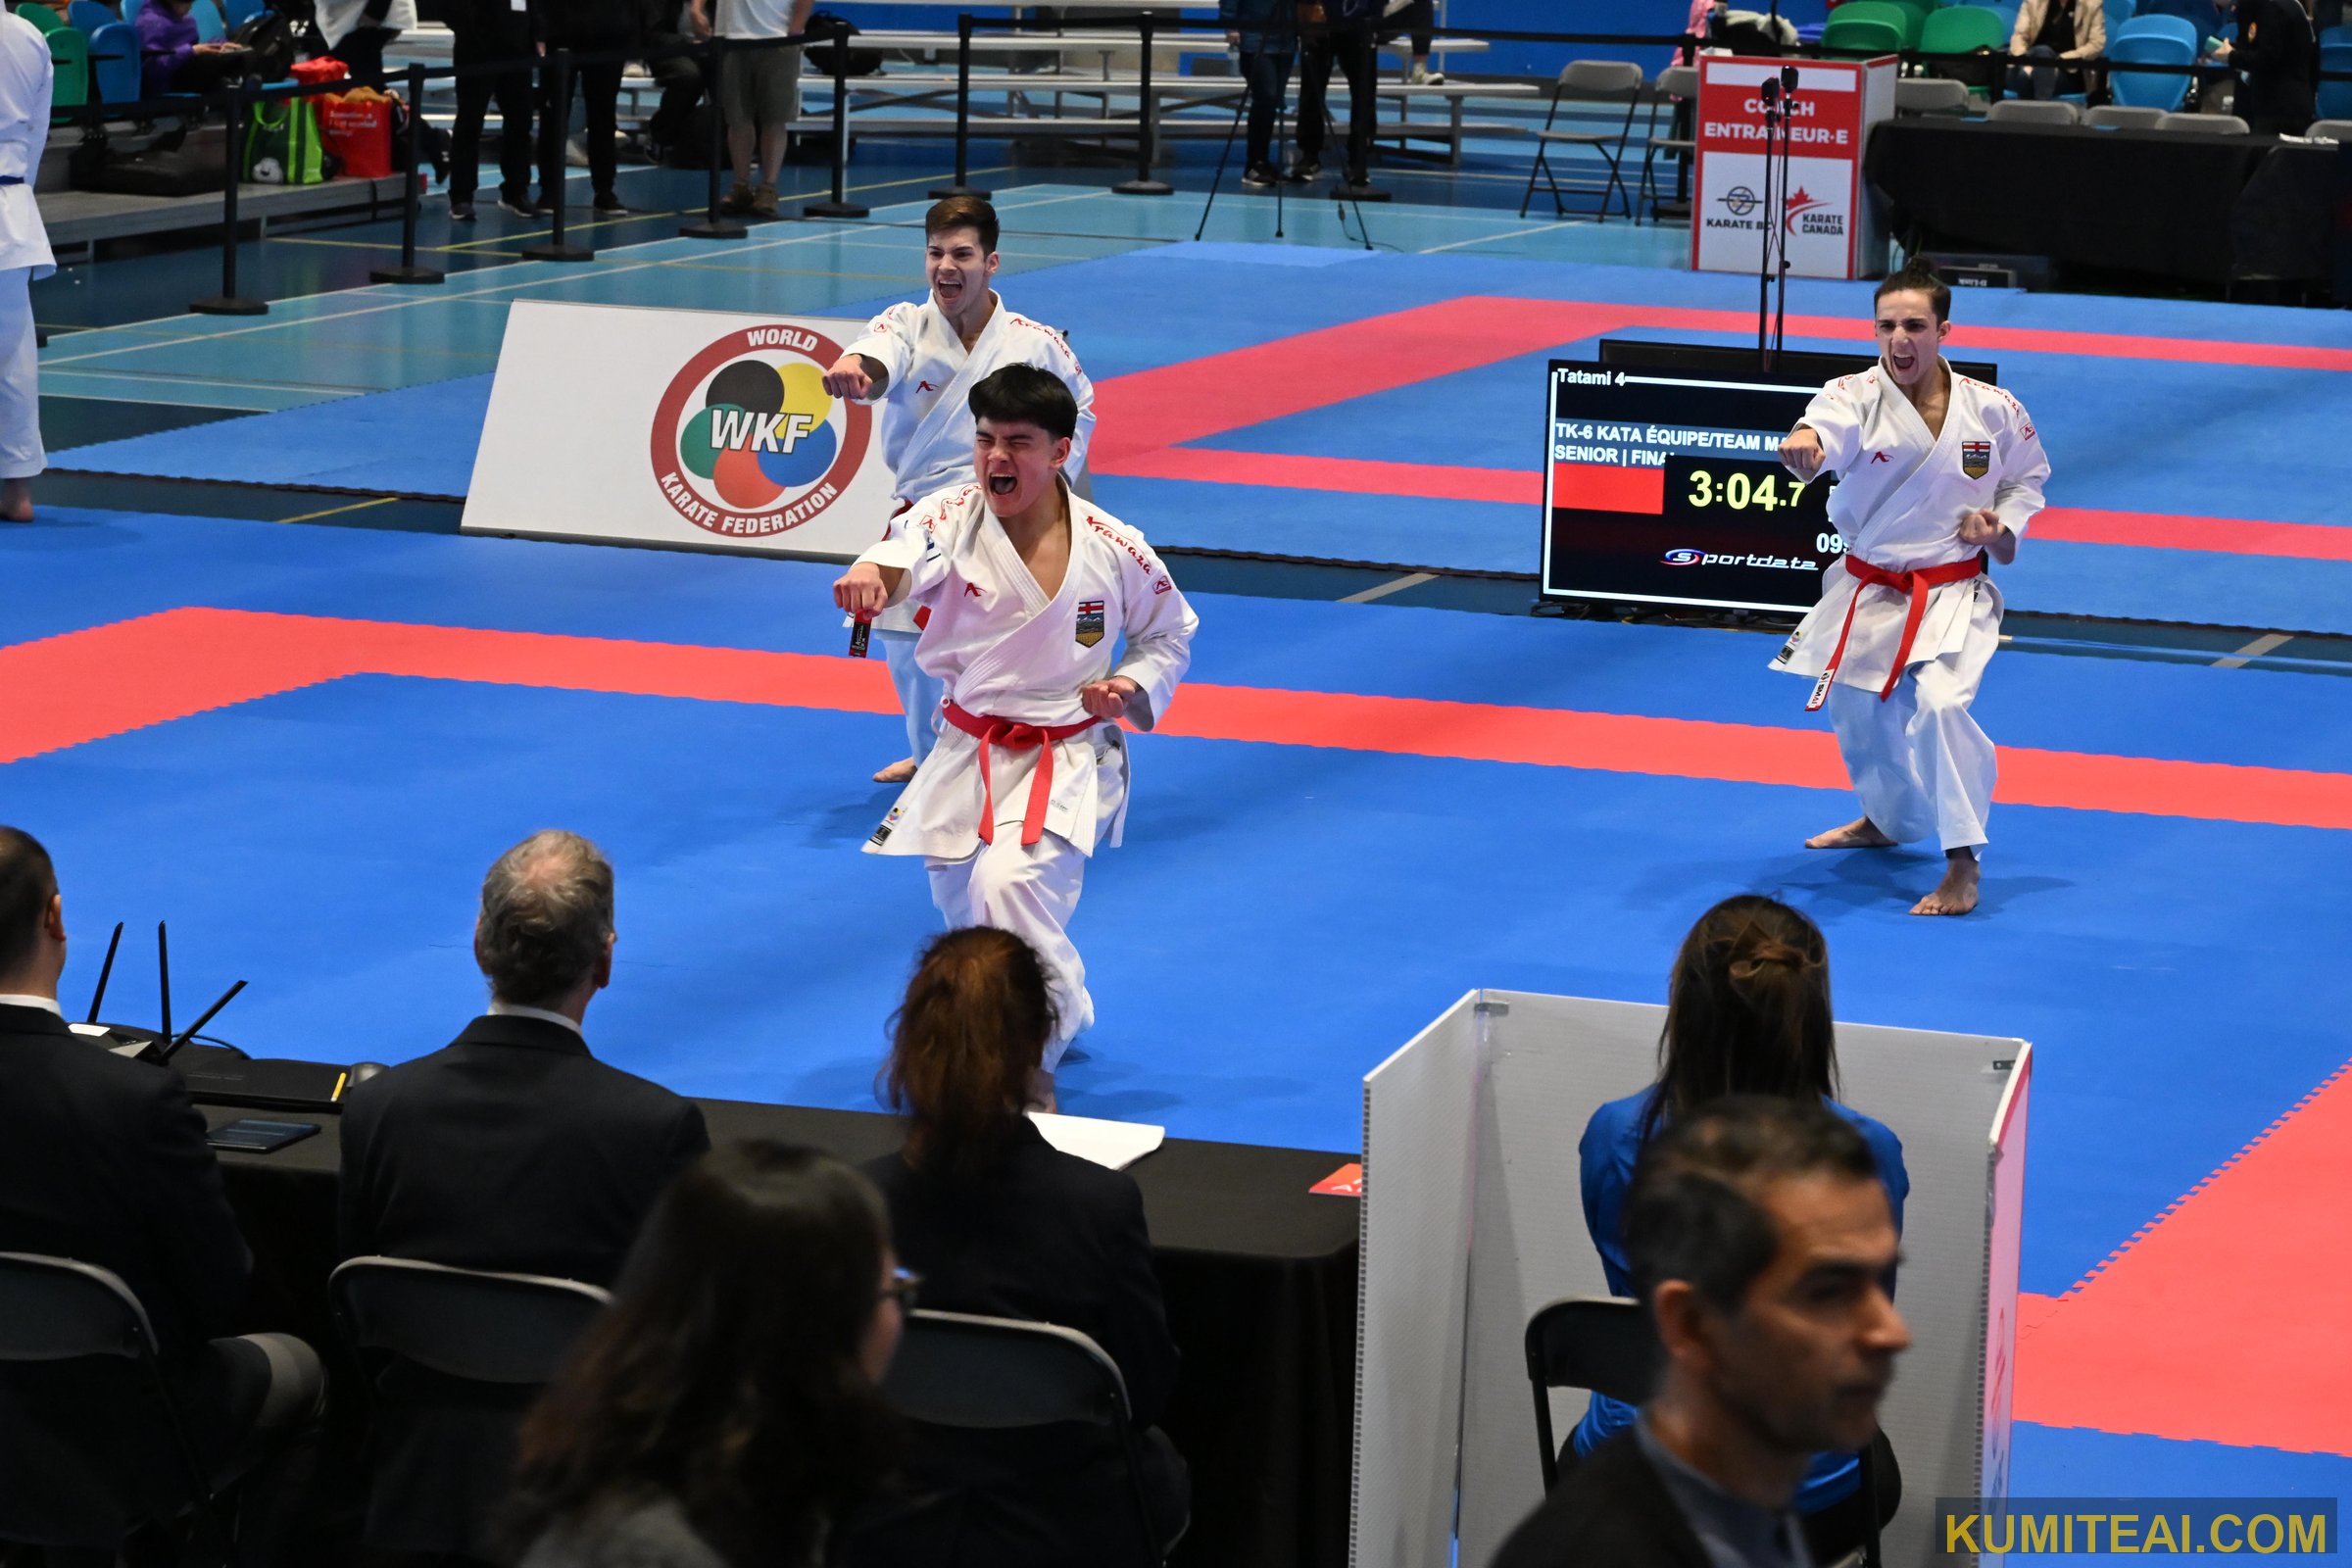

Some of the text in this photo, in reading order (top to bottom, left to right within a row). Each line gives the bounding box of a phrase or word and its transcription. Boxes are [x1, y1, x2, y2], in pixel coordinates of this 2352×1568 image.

[1706, 219, 1753, 230] KARATE
[1801, 224, 1843, 235] CANADA
[1802, 213, 1843, 224] KARATE
[747, 328, 818, 352] WORLD
[1557, 368, 1626, 386] Tatami 4
[710, 408, 813, 454] WKF
[1555, 422, 1593, 440] TK-6
[1596, 425, 1642, 442] KATA
[1646, 424, 1760, 451] ÉQUIPE/TEAM
[1554, 444, 1618, 464] SENIOR
[1631, 450, 1675, 466] FINA
[1688, 469, 1806, 512] 3:04.7
[661, 471, 837, 534] KARATE FEDERATION
